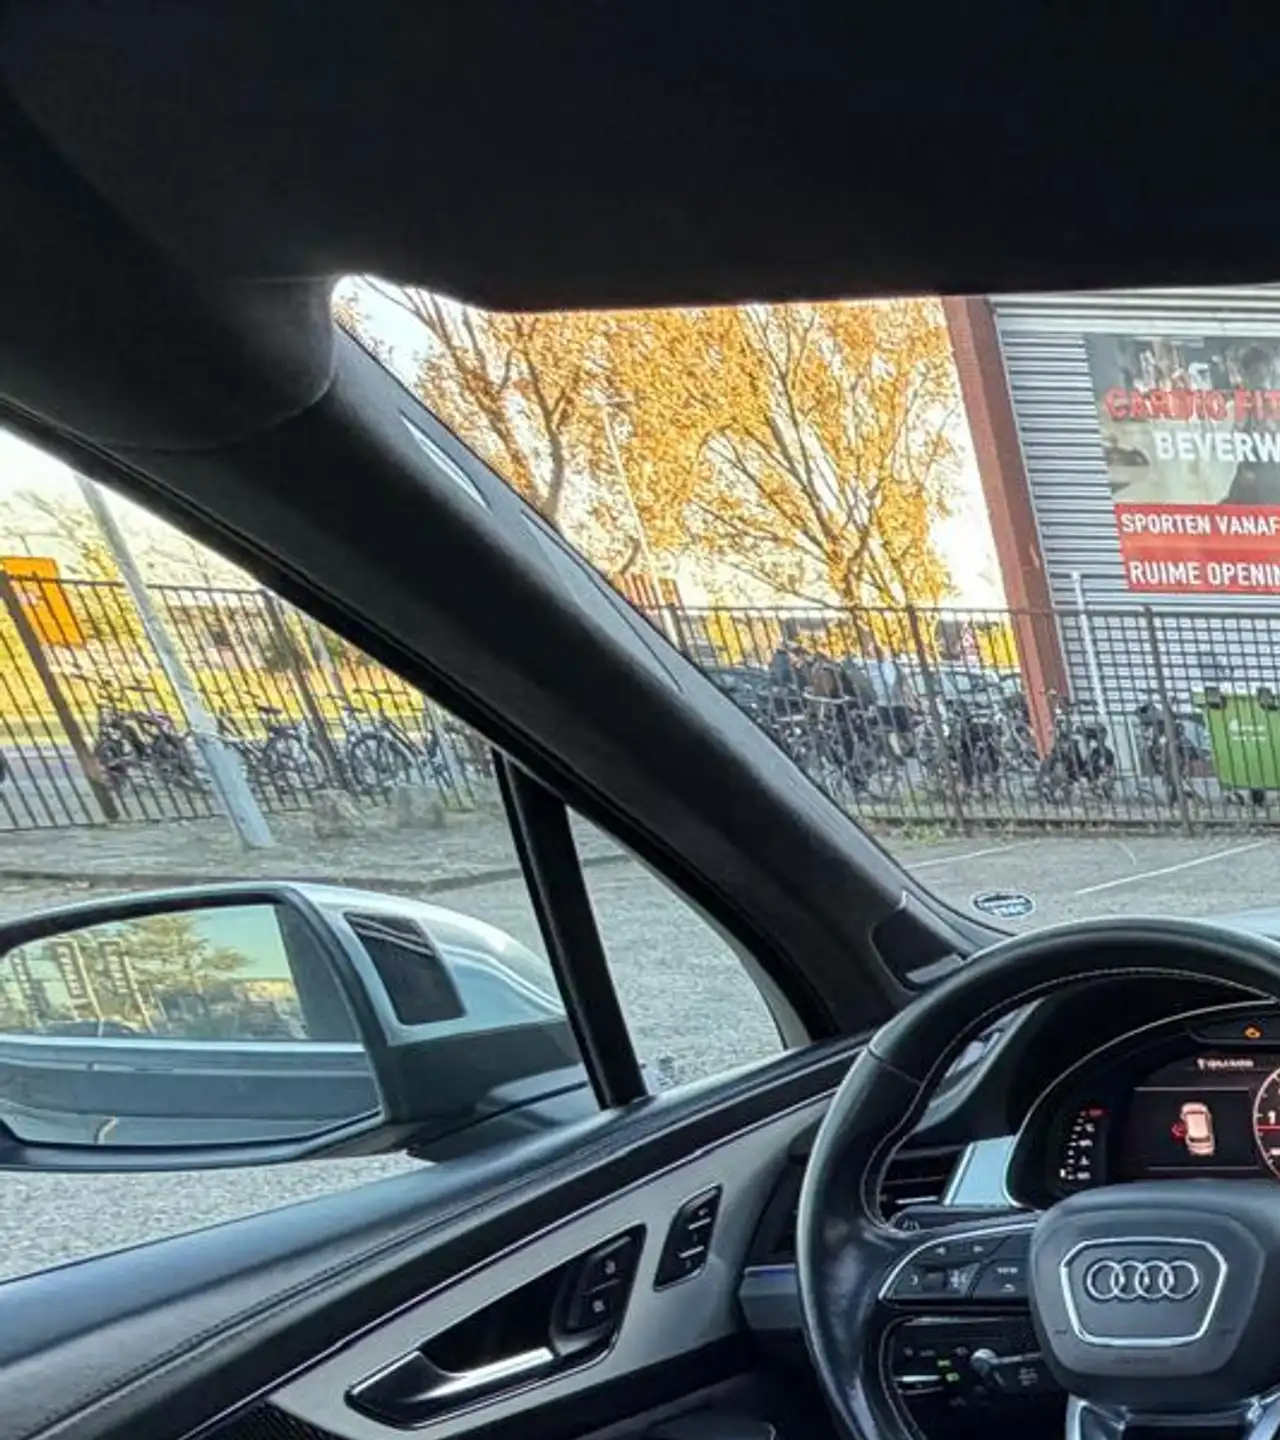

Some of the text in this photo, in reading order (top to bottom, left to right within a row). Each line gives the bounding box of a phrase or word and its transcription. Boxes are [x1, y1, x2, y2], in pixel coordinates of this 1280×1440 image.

[1104, 388, 1229, 423] CARDIO
[1121, 513, 1210, 535] SPORTEN
[1218, 515, 1280, 535] VANAF
[1129, 560, 1206, 585] RUIME
[1267, 1111, 1277, 1125] 1
